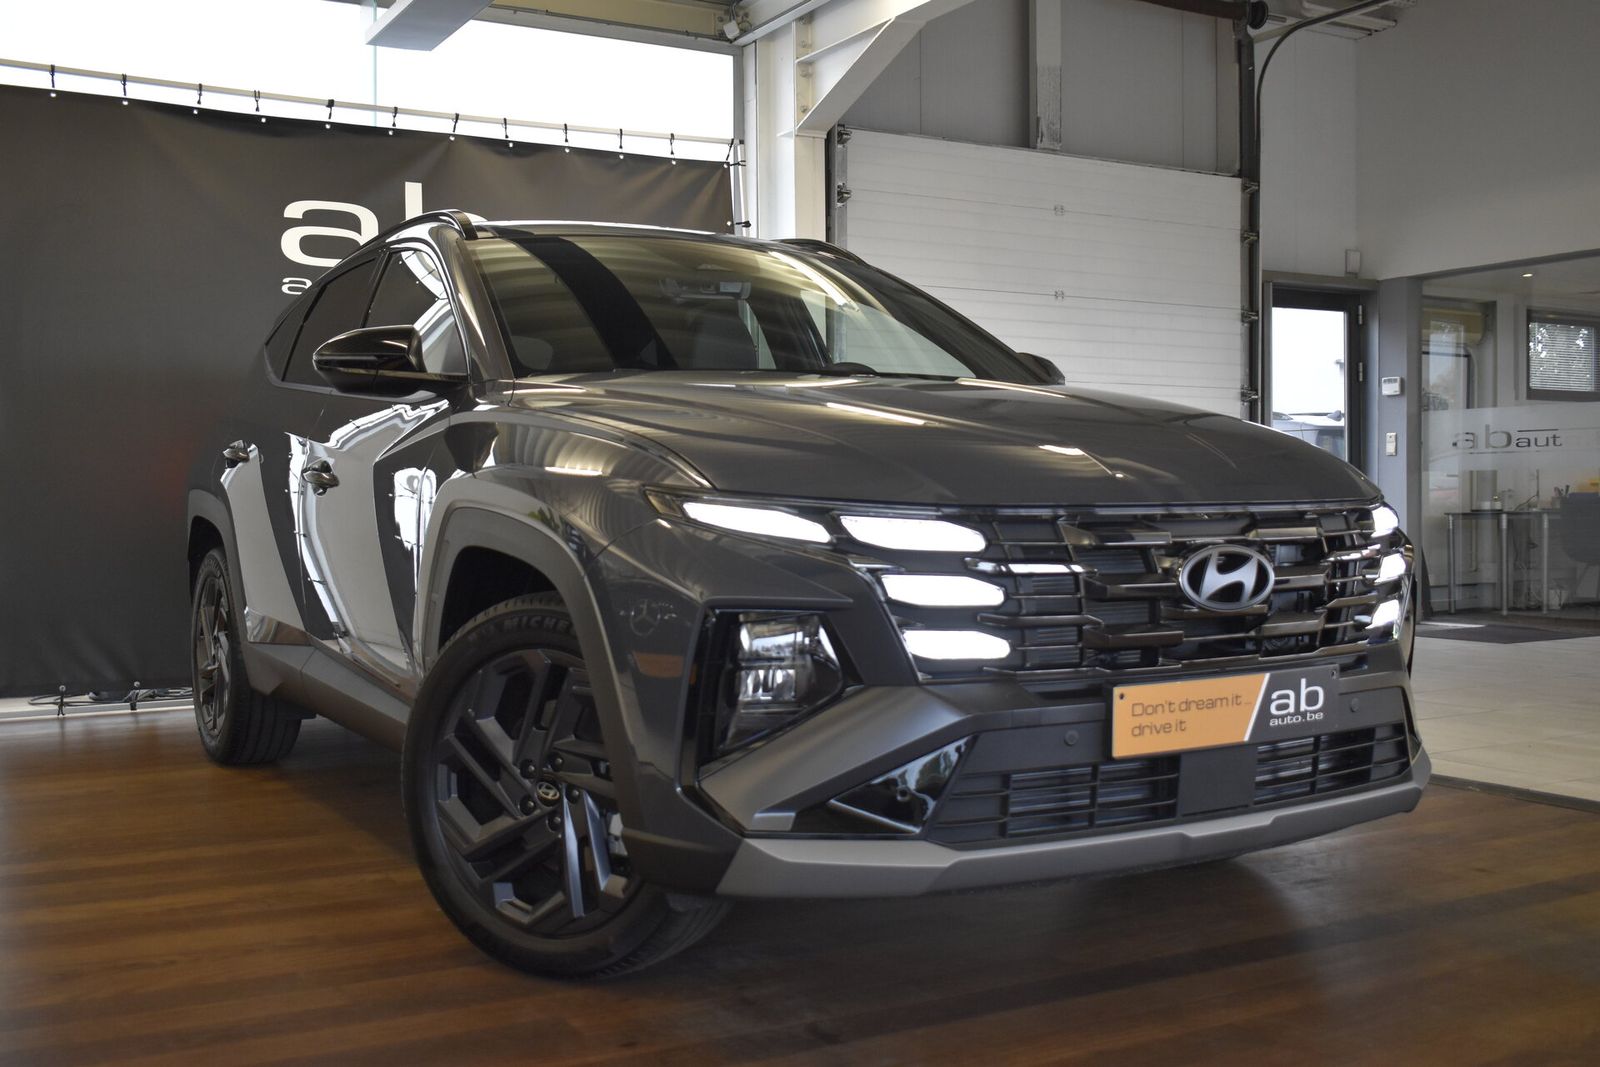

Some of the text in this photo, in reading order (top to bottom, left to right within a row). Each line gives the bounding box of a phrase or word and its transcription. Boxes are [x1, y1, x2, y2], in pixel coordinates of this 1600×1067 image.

[1269, 678, 1325, 715] ab
[1131, 699, 1177, 717] Don't
[1180, 696, 1227, 712] dream
[1131, 719, 1187, 737] drive it
[1269, 712, 1324, 727] auto.be
